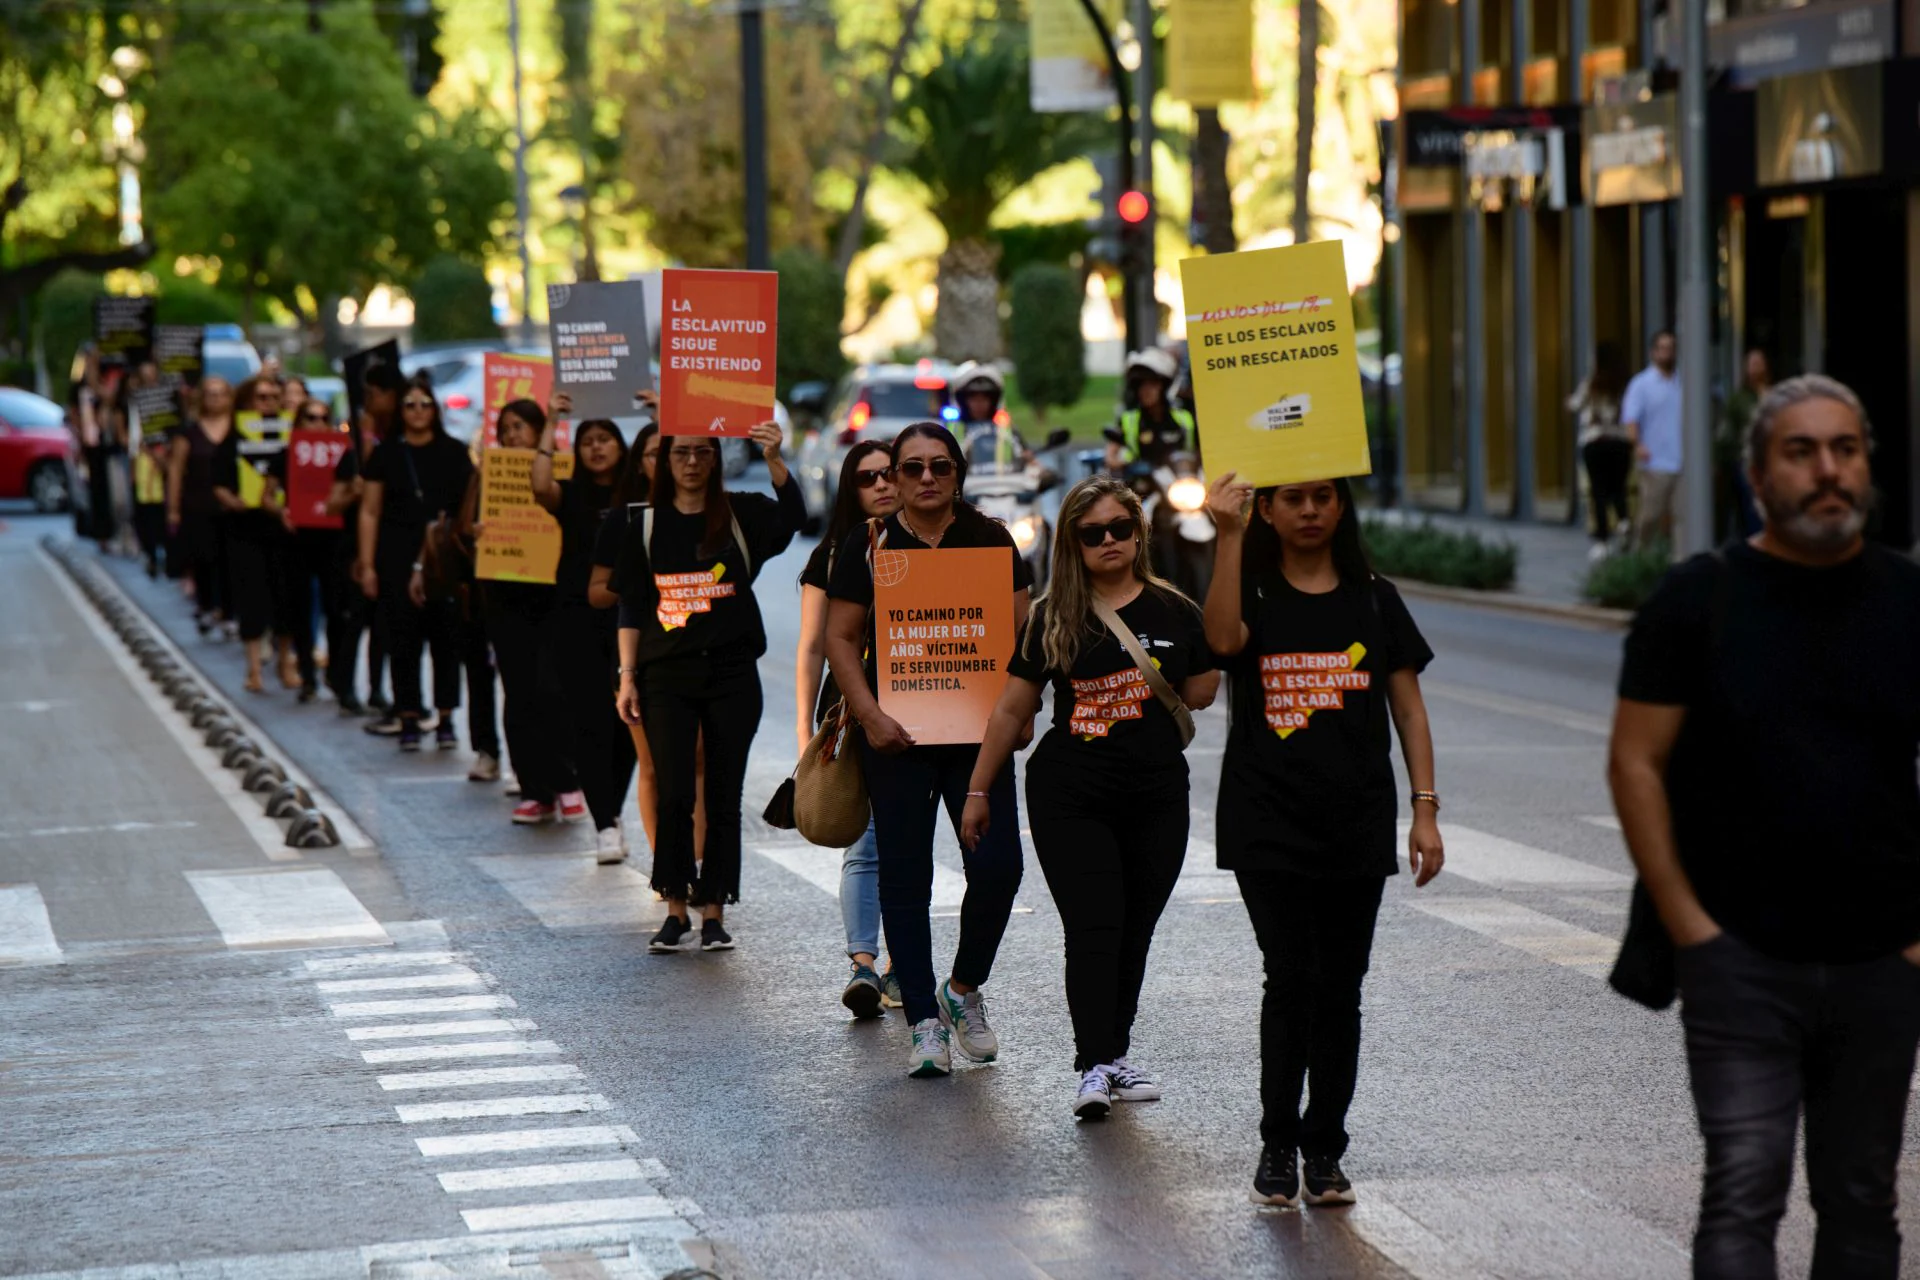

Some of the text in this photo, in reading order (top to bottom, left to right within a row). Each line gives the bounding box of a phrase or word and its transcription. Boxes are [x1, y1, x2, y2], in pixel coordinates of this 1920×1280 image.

[672, 298, 692, 312] LA
[1201, 295, 1320, 323] MENOS DEL 1%
[570, 321, 607, 334] CAMINO
[672, 317, 766, 333] ESCLAVITUD
[1204, 320, 1336, 346] DE LOS ESCLAVOS
[671, 337, 717, 351] SIGUE
[671, 356, 761, 371] EXISTIENDO
[1207, 344, 1339, 371] SON RESCATADOS
[680, 600, 708, 612] CADA
[888, 607, 983, 622] YO CAMINO POR
[889, 624, 985, 640] LA MUJER DE 70
[890, 640, 977, 657] AÑOS VÍCTIMA
[891, 659, 996, 675] DE SERVIDUMBRE
[1262, 655, 1349, 670] ABOLIENDO
[892, 676, 965, 692] DOMÉSTICA.
[1286, 673, 1370, 689] ESCLAVITU
[1267, 693, 1340, 708] CON CADA
[1076, 705, 1139, 719] CON CADA
[1266, 712, 1305, 726] PASO
[1072, 722, 1106, 734] PASO
